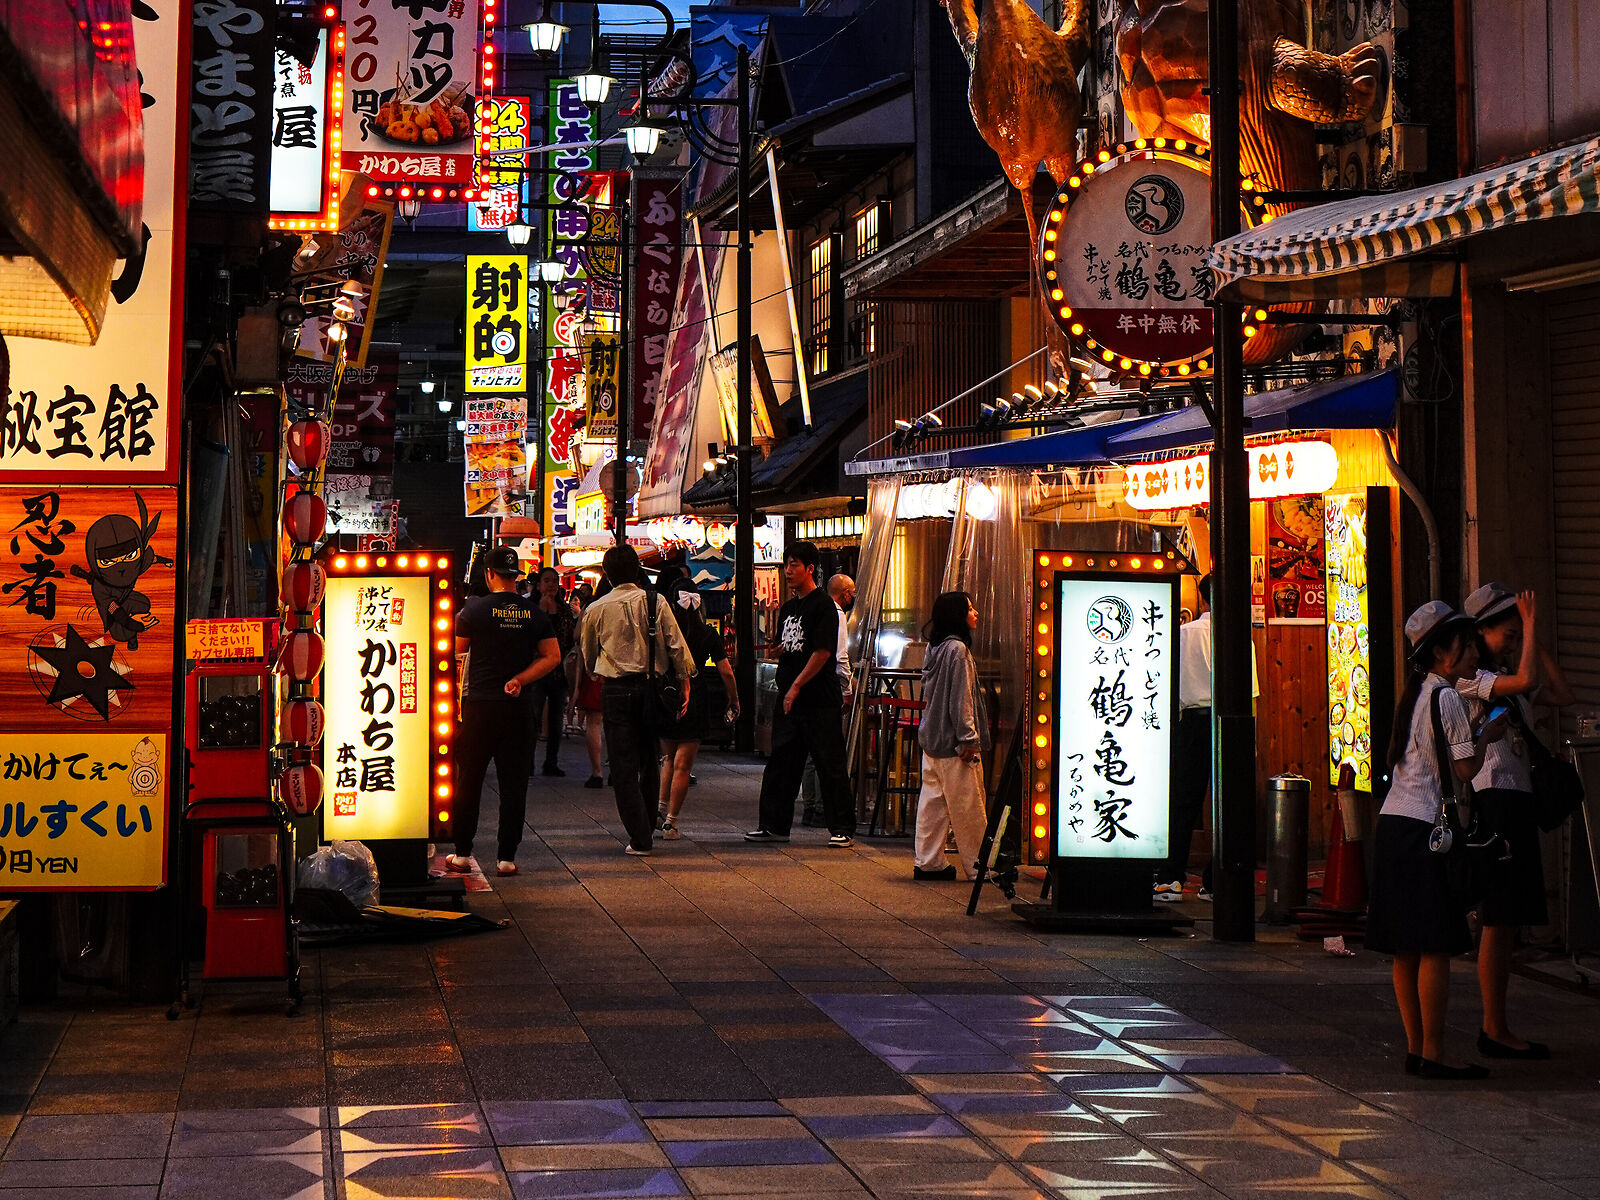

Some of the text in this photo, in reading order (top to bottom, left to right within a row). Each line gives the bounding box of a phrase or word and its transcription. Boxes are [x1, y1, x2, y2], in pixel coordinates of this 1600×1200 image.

[273, 105, 317, 148] 屋
[475, 100, 526, 134] 24
[359, 155, 456, 177] かわち屋 本店
[592, 211, 619, 238] 24
[1083, 243, 1099, 285] 串かつ
[1114, 241, 1152, 258] 名代
[1098, 259, 1112, 301] どて焼
[1114, 257, 1213, 301] 鶴亀家
[472, 262, 523, 363] 射的
[1116, 313, 1201, 335] 年中無休
[472, 376, 522, 386] チャンピオン
[0, 382, 159, 465] 秘宝館
[2, 491, 77, 620] 忍者
[188, 623, 260, 635] ゴミ捨てないで
[492, 608, 531, 619] PREMIUM
[200, 636, 250, 646] ください!!
[1088, 646, 1133, 666] 名代
[400, 645, 415, 710] 大阪新世界
[1141, 599, 1162, 730] 串かつ どて焼
[357, 639, 397, 792] かわち屋
[336, 743, 357, 788] 本店
[1087, 669, 1140, 843] 鶴亀家
[1067, 752, 1085, 835] つるかめや
[35, 856, 78, 874] YEN
